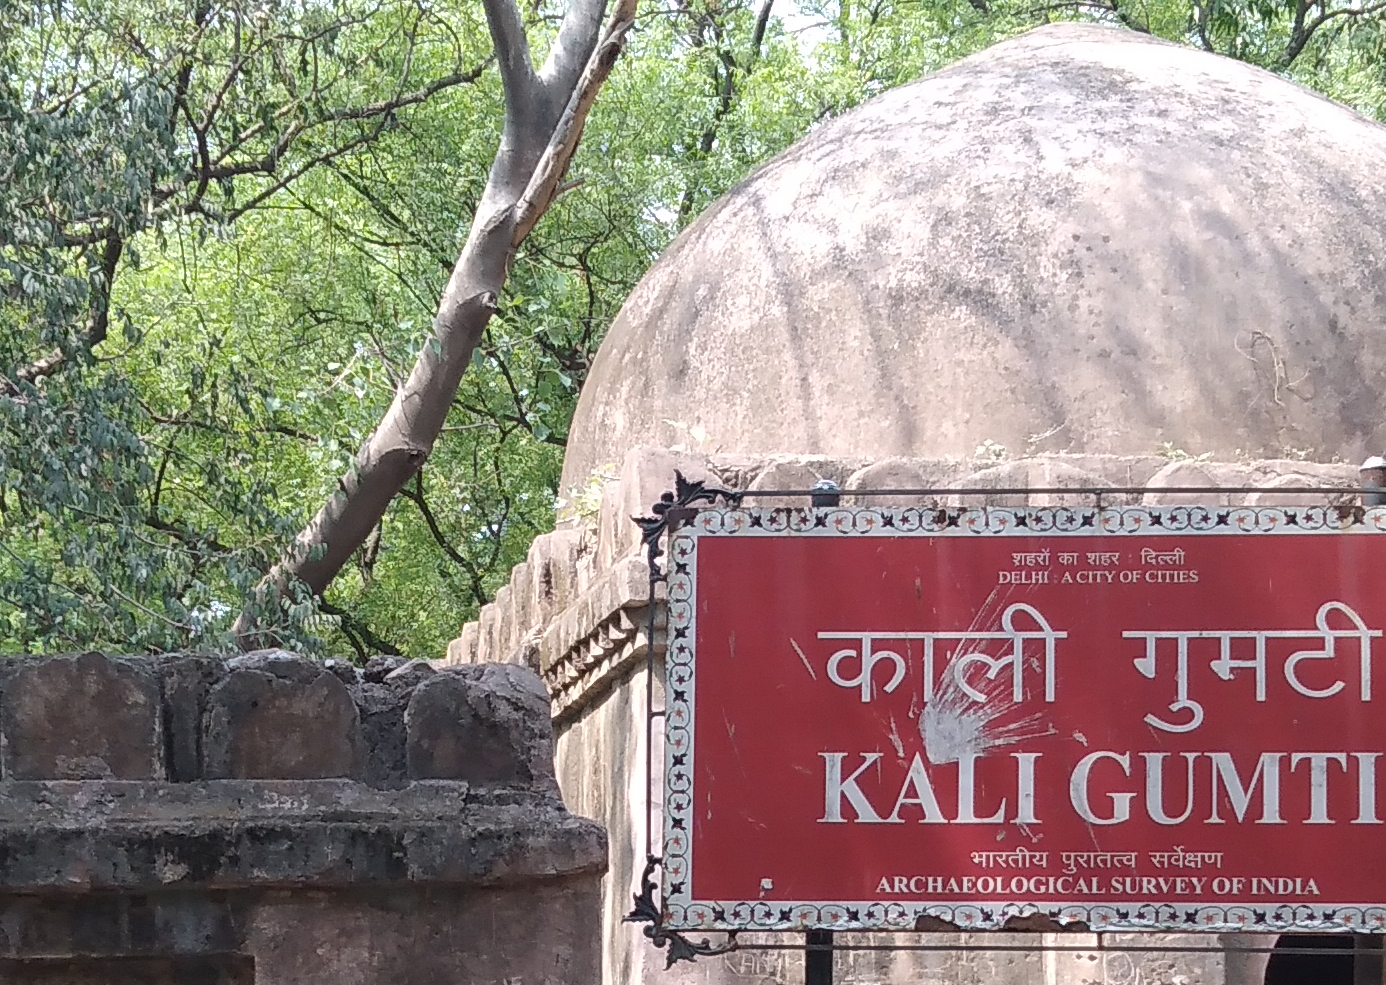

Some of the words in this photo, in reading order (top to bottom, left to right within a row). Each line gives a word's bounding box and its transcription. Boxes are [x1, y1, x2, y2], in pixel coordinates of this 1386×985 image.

[1012, 548, 1051, 567] शहरों
[1058, 552, 1078, 566] का
[1086, 552, 1120, 566] शहर
[1141, 547, 1185, 566] दिल्ली
[998, 570, 1049, 584] DELHI
[1061, 571, 1074, 584] A
[1076, 570, 1116, 584] CITY
[1119, 570, 1142, 583] OF
[1144, 569, 1200, 583] CITIES
[817, 601, 1067, 702] काली
[1122, 600, 1383, 732] गुमटी
[816, 751, 1040, 825] KALI
[1069, 751, 1384, 825] GUMTI
[970, 847, 1048, 869] भारतीय
[1060, 851, 1139, 873] पुरातत्व
[1148, 846, 1223, 869] सर्वेक्षण
[875, 876, 1106, 895] ARCHAEOLOGICAL
[1110, 876, 1208, 895] SURVEY
[1212, 876, 1247, 895] OF
[1250, 877, 1321, 895] INDIA
